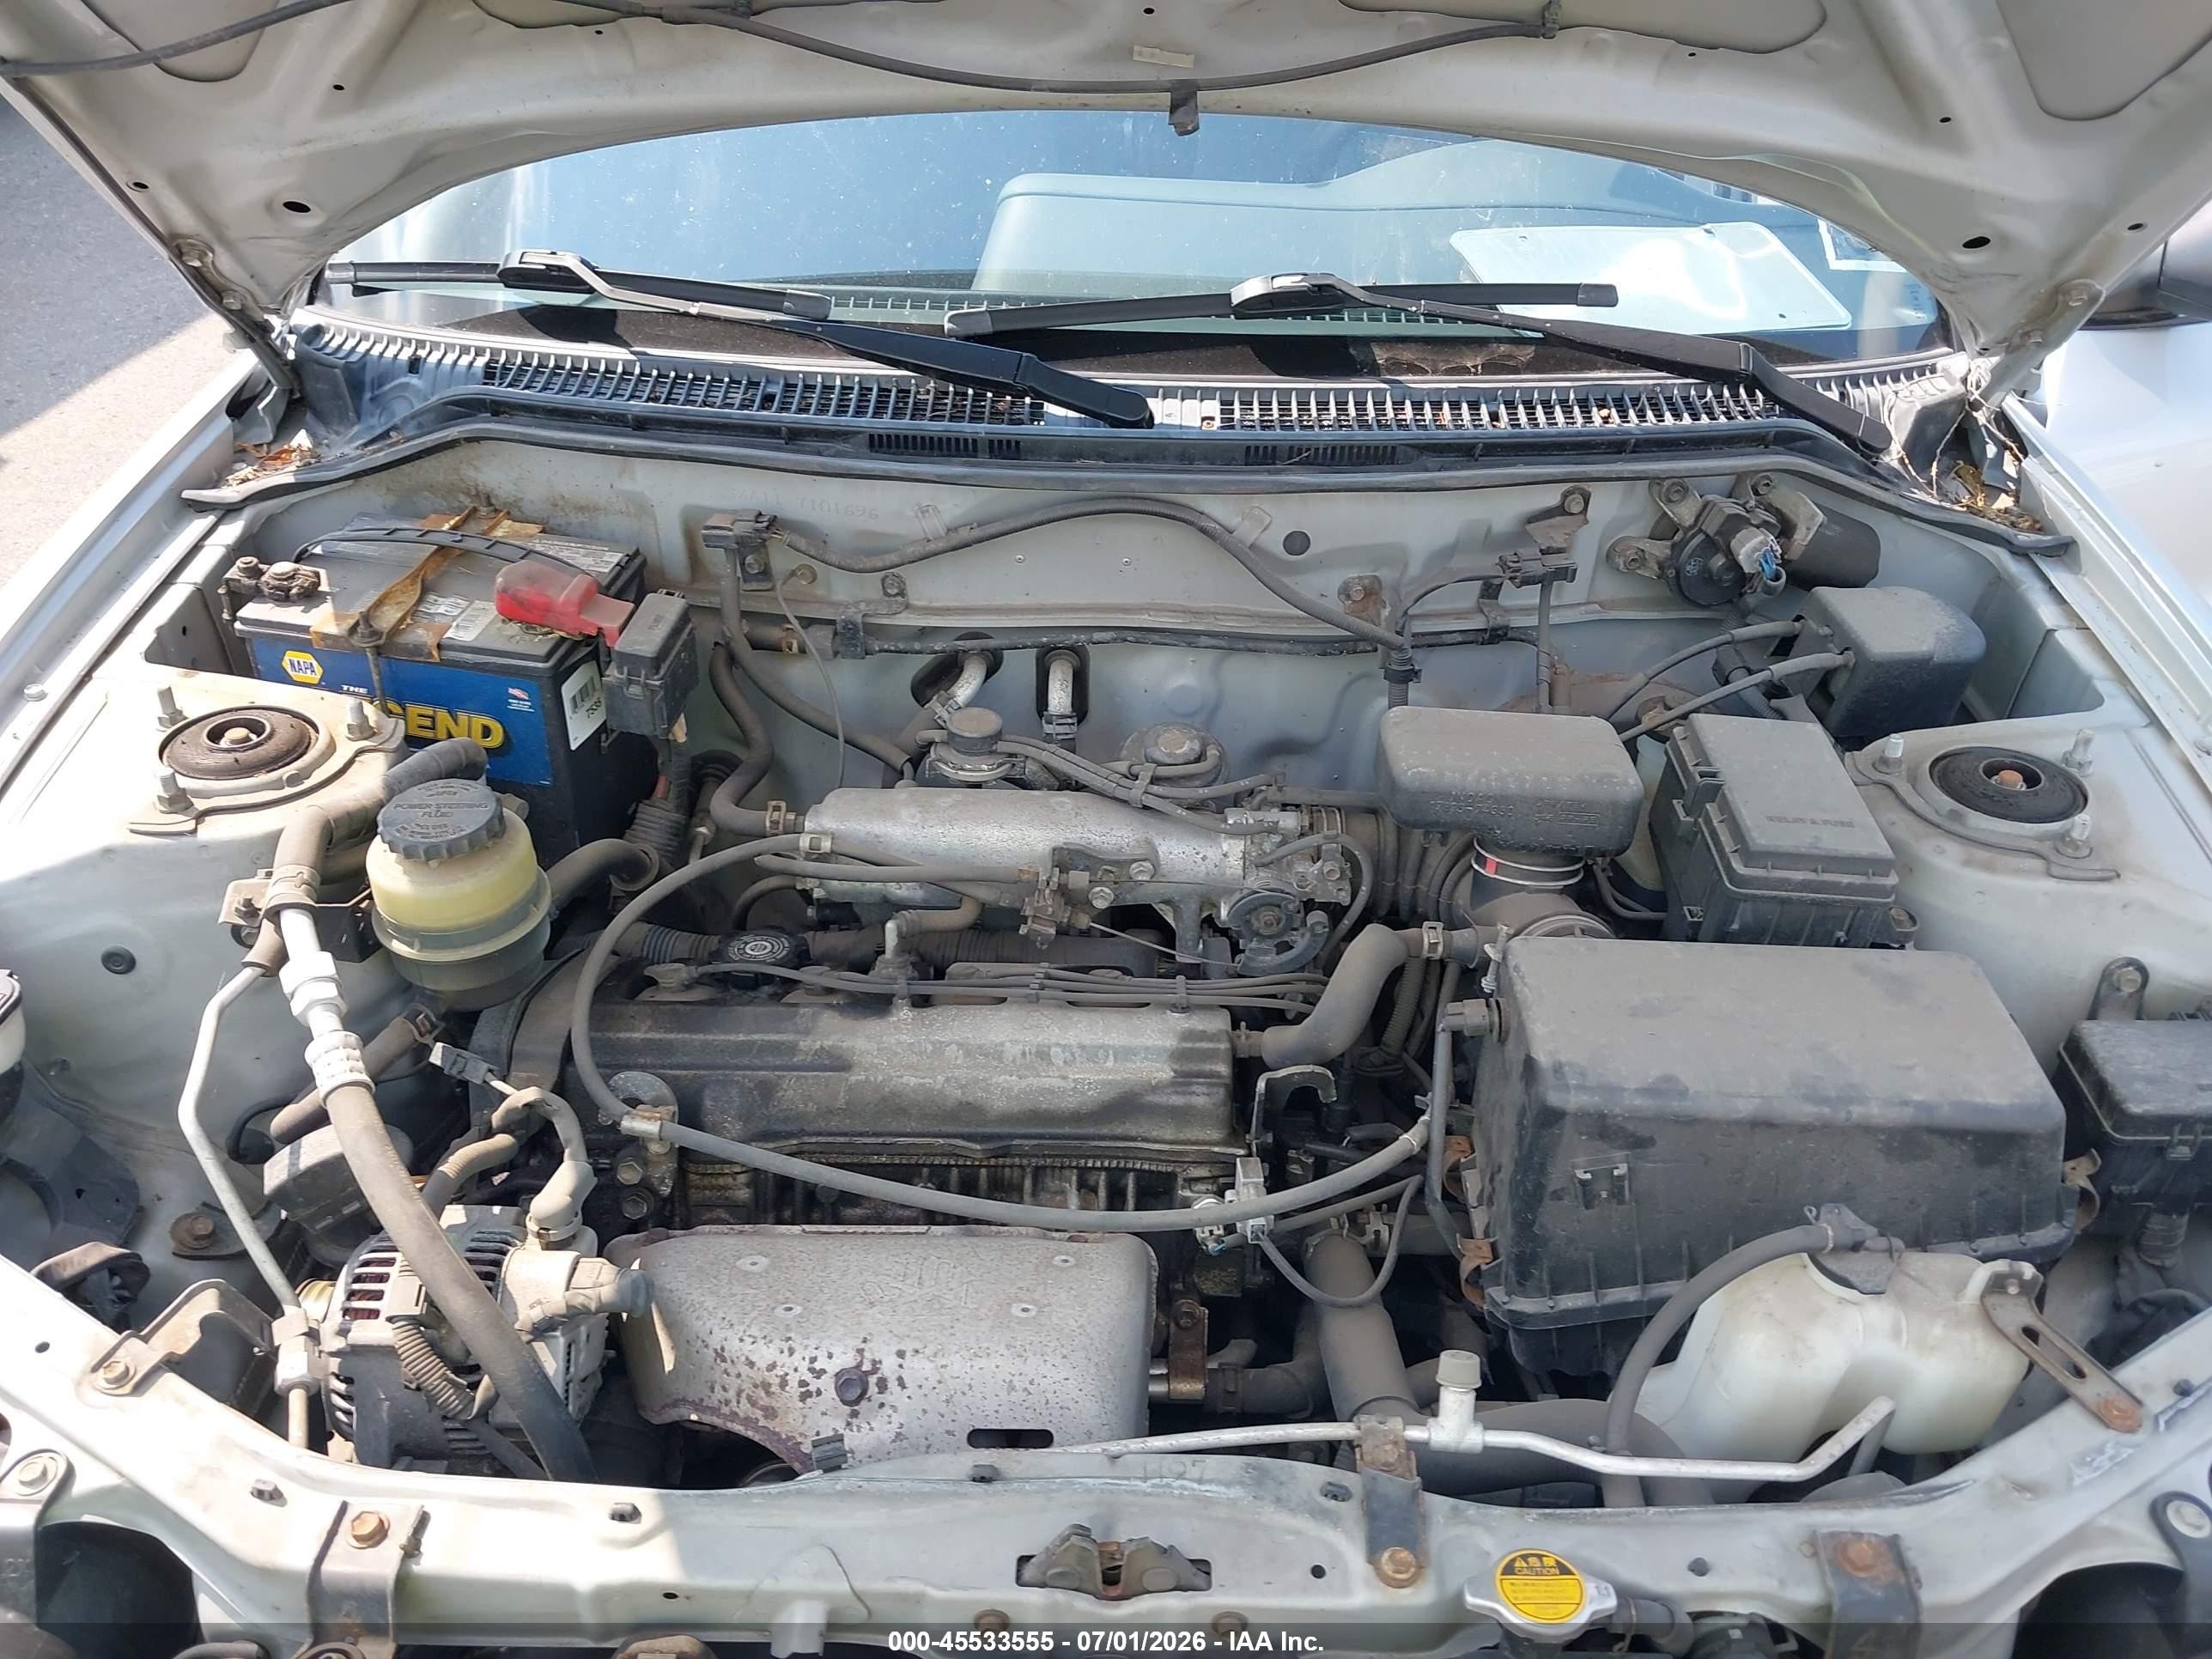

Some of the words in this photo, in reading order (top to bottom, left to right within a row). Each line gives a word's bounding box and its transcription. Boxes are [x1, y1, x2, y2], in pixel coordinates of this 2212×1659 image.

[289, 658, 317, 677] NAPA
[341, 684, 368, 695] THE
[420, 810, 454, 818] FLUID
[1514, 1566, 1560, 1576] CAUTION
